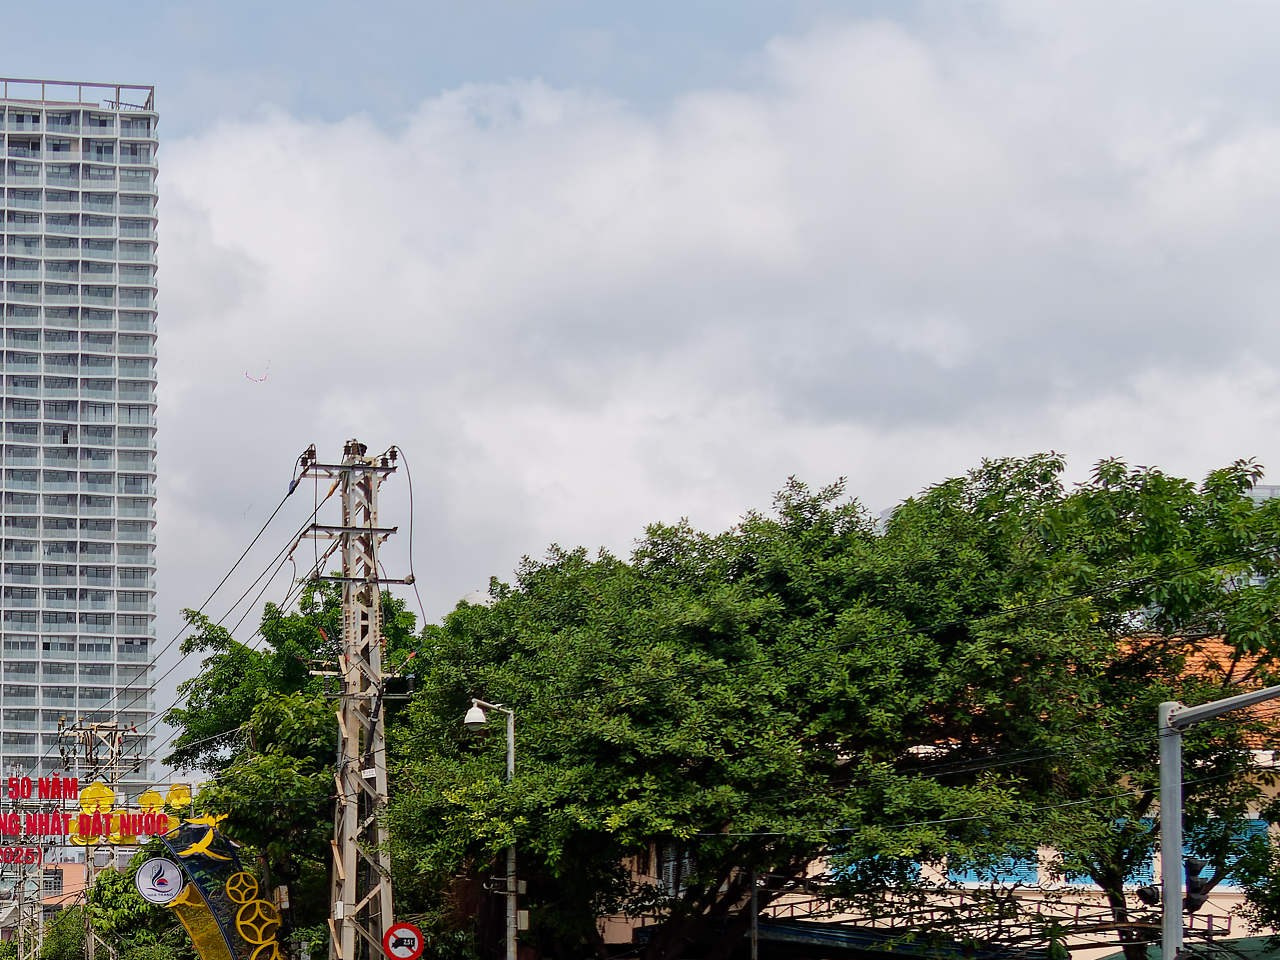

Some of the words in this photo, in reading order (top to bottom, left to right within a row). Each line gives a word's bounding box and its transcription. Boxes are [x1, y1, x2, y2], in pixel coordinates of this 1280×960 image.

[8, 776, 32, 800] 50
[38, 771, 78, 800] NĂM
[25, 804, 72, 836] NHẤT
[119, 805, 168, 837] NƯỚC
